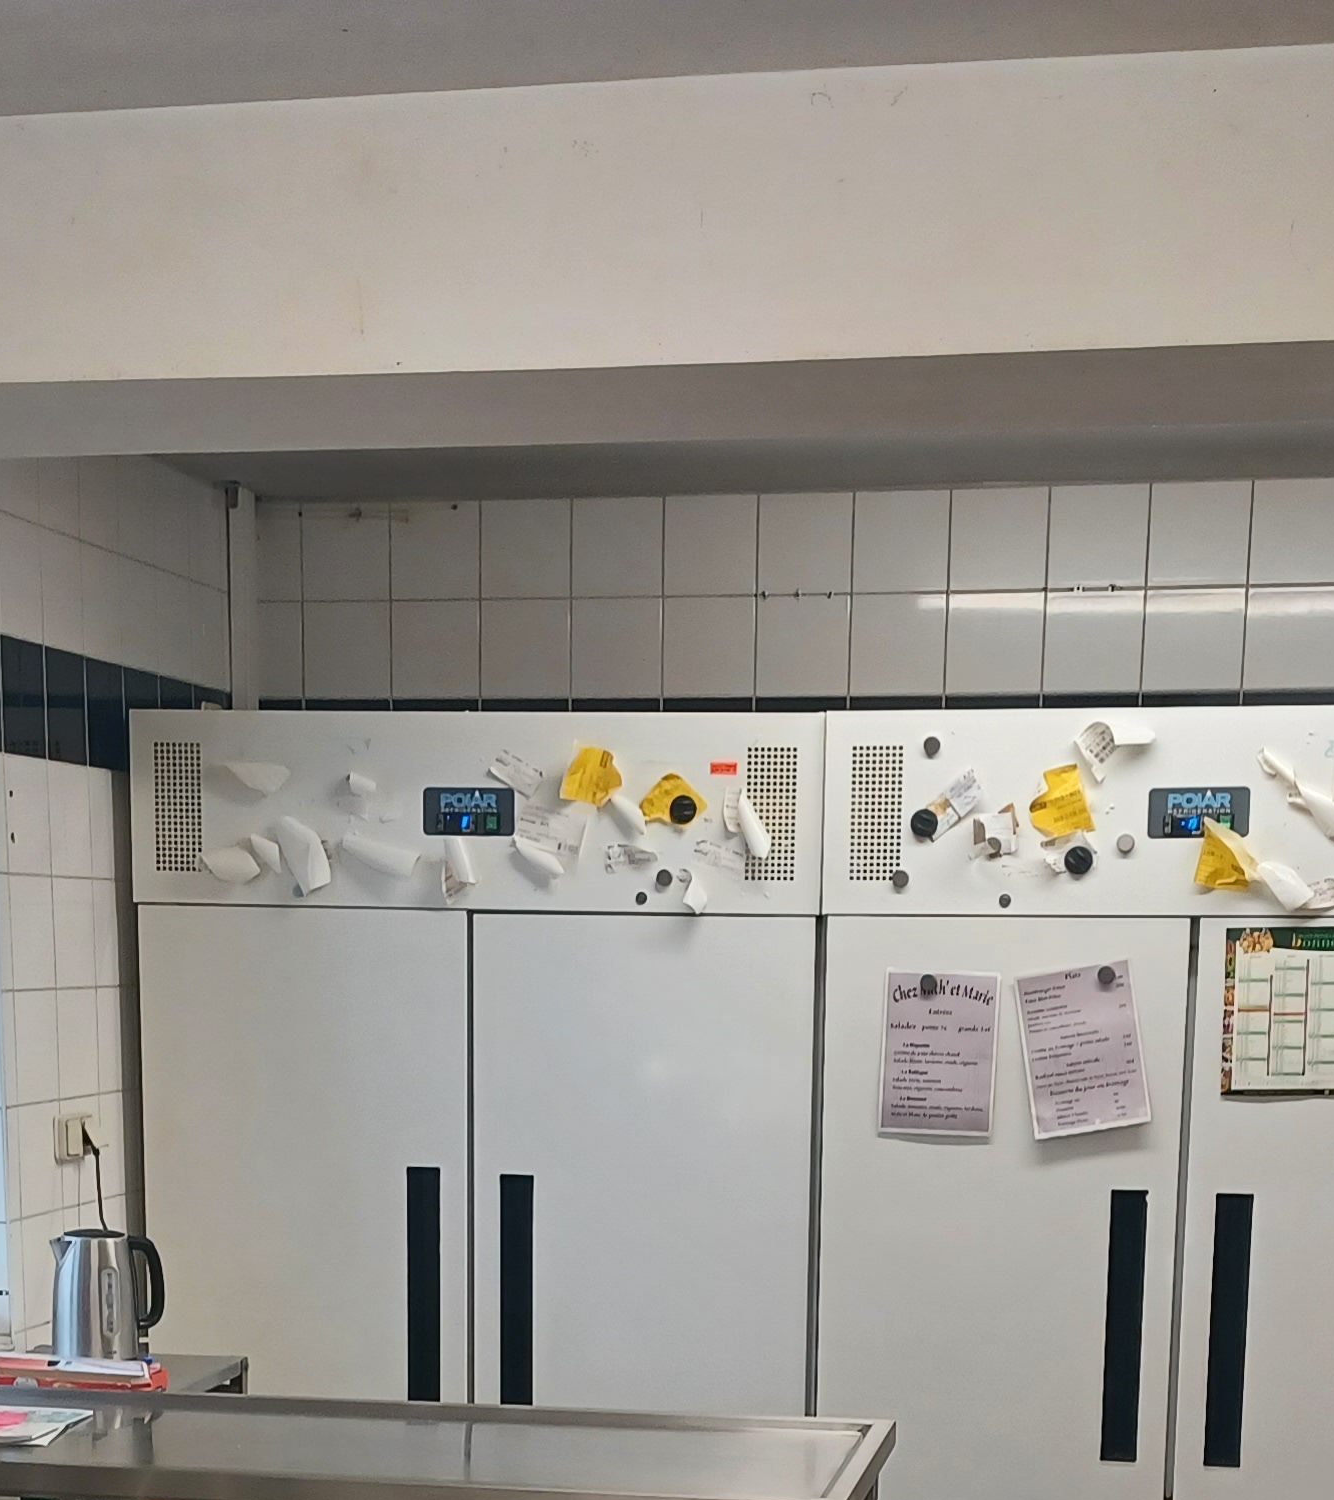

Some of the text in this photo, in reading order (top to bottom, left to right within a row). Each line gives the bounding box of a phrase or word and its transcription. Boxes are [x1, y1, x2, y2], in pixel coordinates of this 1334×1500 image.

[440, 789, 497, 808] POLAR
[1167, 789, 1231, 808] POLAR
[893, 985, 918, 1003] Chez
[950, 983, 961, 996] et
[961, 984, 994, 1006] Marie
